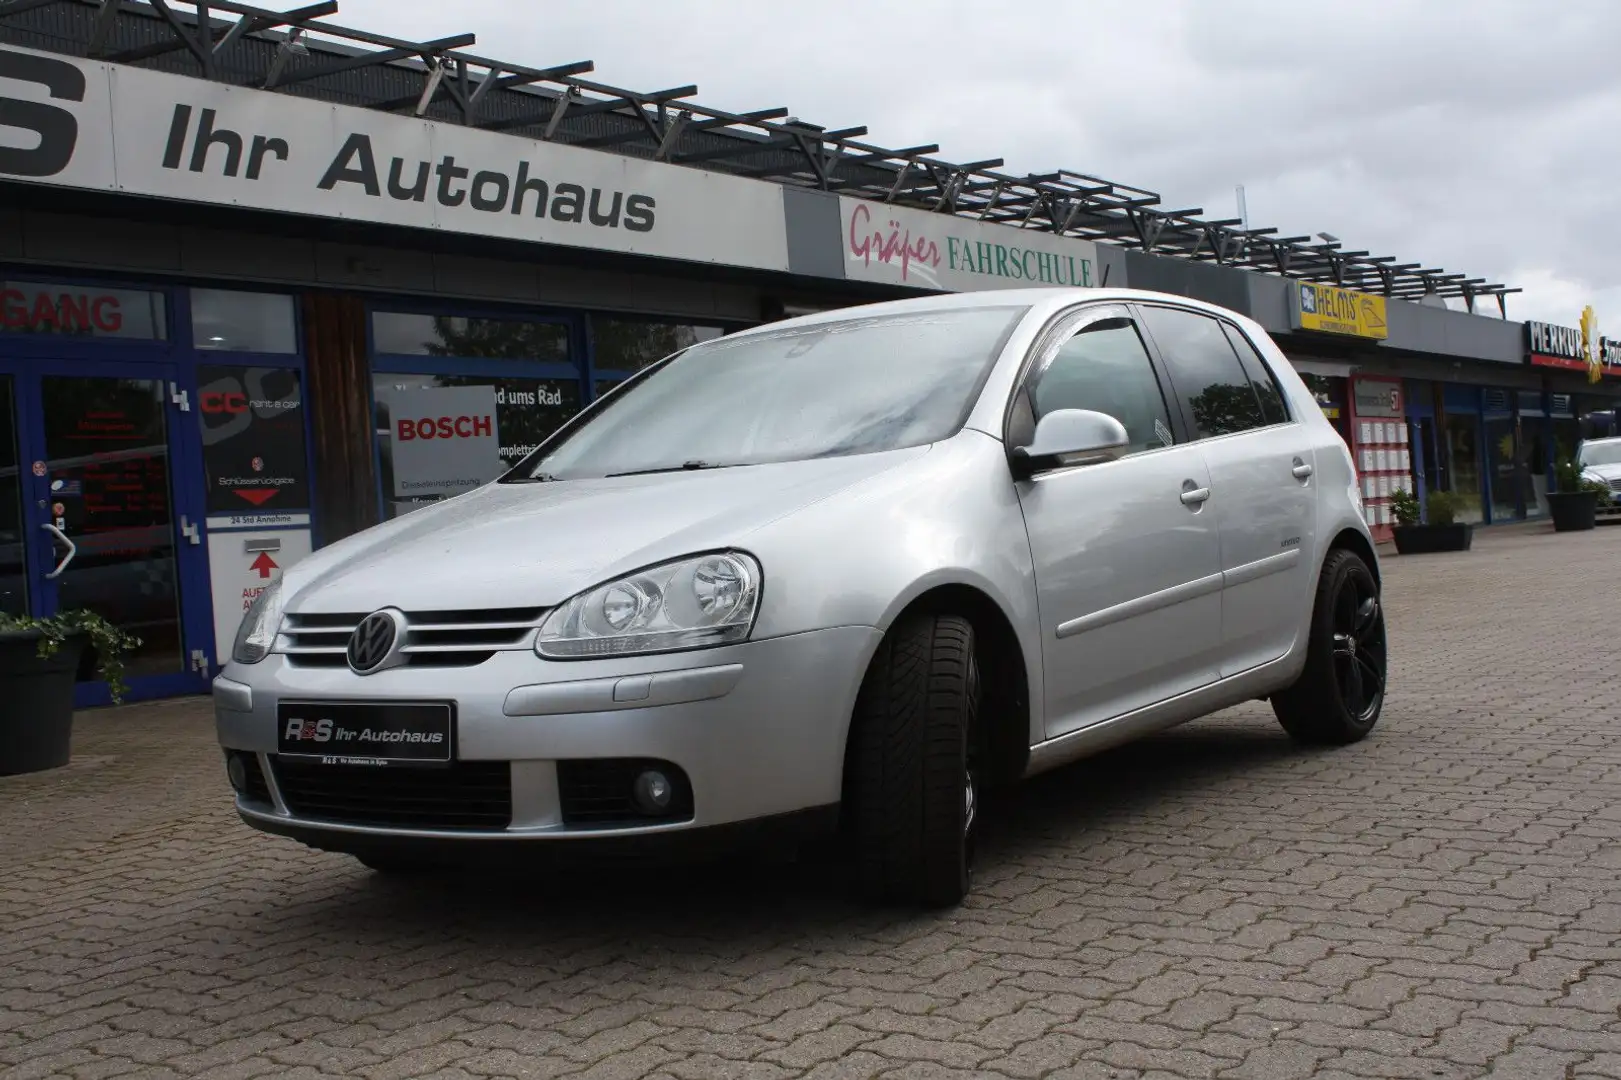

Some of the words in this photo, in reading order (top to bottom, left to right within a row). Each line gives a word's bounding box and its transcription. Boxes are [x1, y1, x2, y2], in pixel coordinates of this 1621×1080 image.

[162, 103, 288, 181] Ihr
[317, 132, 655, 233] Autohaus
[850, 203, 941, 281] Gräper
[946, 236, 1093, 288] FAHRSCHULE
[0, 288, 122, 332] GANG
[1530, 321, 1585, 359] MERKUR
[201, 393, 248, 413] CC
[509, 391, 536, 405] ums
[538, 388, 562, 405] Rad
[398, 415, 491, 441] BOSCH
[231, 516, 241, 524] 24
[242, 515, 255, 524] Std
[242, 587, 265, 598] AUF
[285, 717, 333, 742] R&S
[335, 727, 357, 742] Ihr
[358, 728, 443, 744] Autohaus
